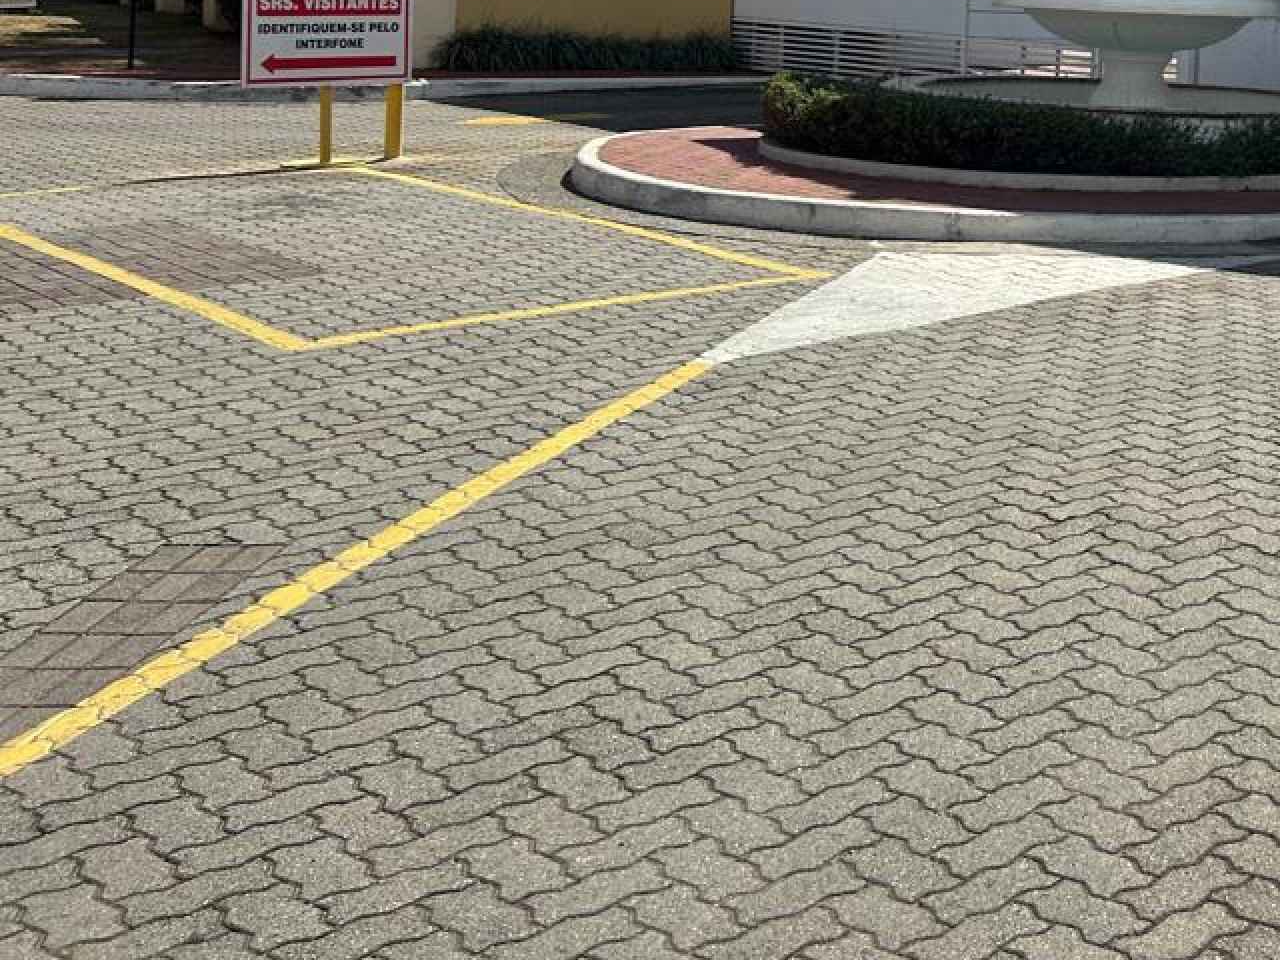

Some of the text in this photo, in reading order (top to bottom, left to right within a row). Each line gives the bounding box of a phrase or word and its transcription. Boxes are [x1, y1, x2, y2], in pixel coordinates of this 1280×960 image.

[256, 21, 399, 35] IDENTIFIQUEM-SE PELO
[295, 37, 365, 50] INTERFONE
